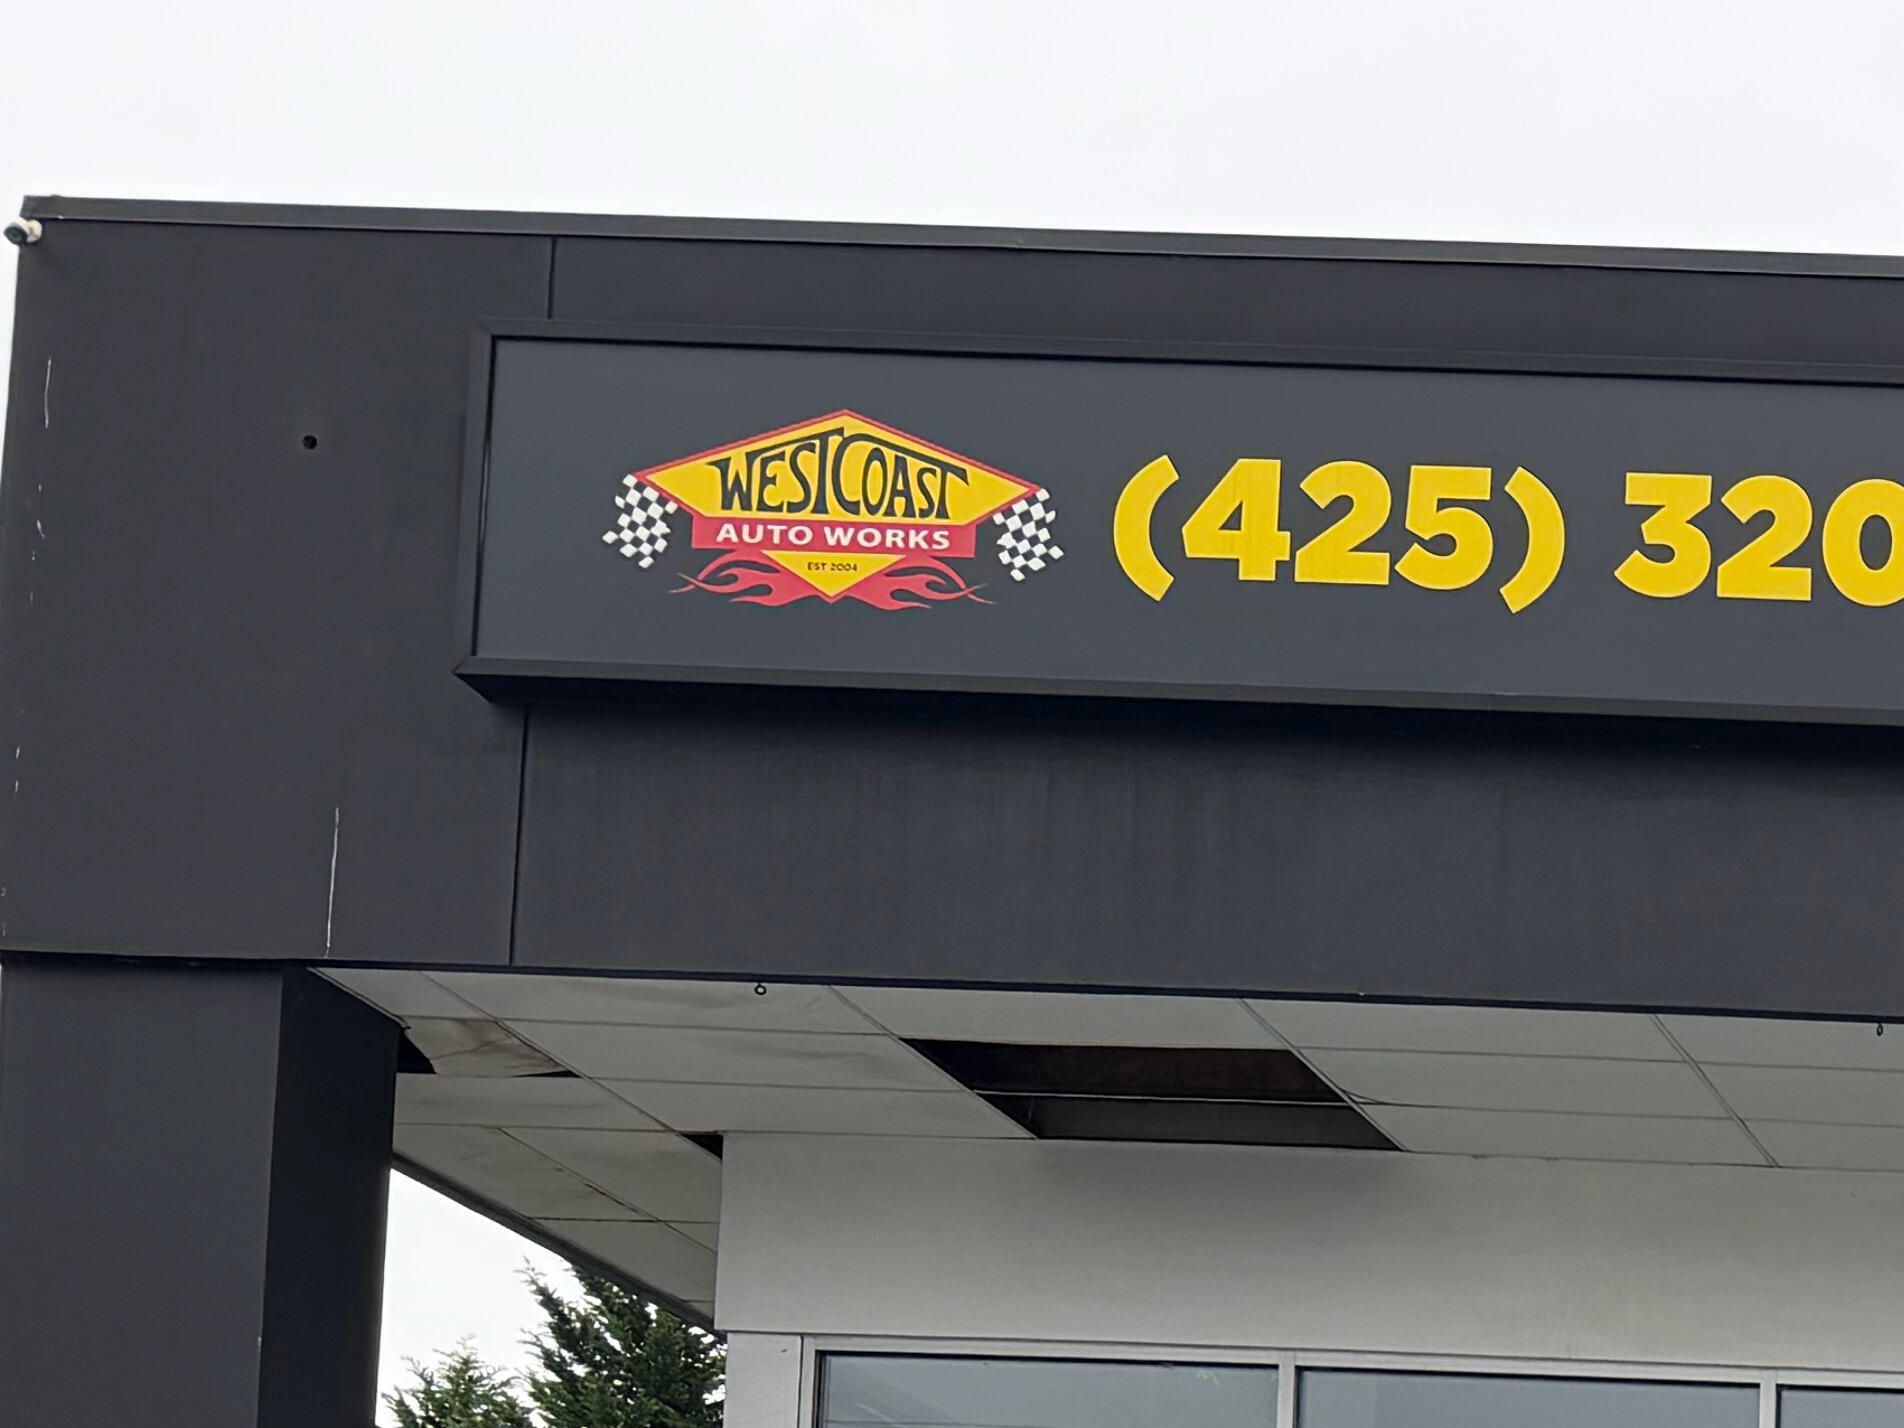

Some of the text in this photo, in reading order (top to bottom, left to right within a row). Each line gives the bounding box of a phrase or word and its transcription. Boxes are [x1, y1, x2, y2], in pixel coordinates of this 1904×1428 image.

[715, 522, 951, 551] AUTO WORKS
[1114, 456, 1564, 613] (425)
[807, 561, 827, 571] EST
